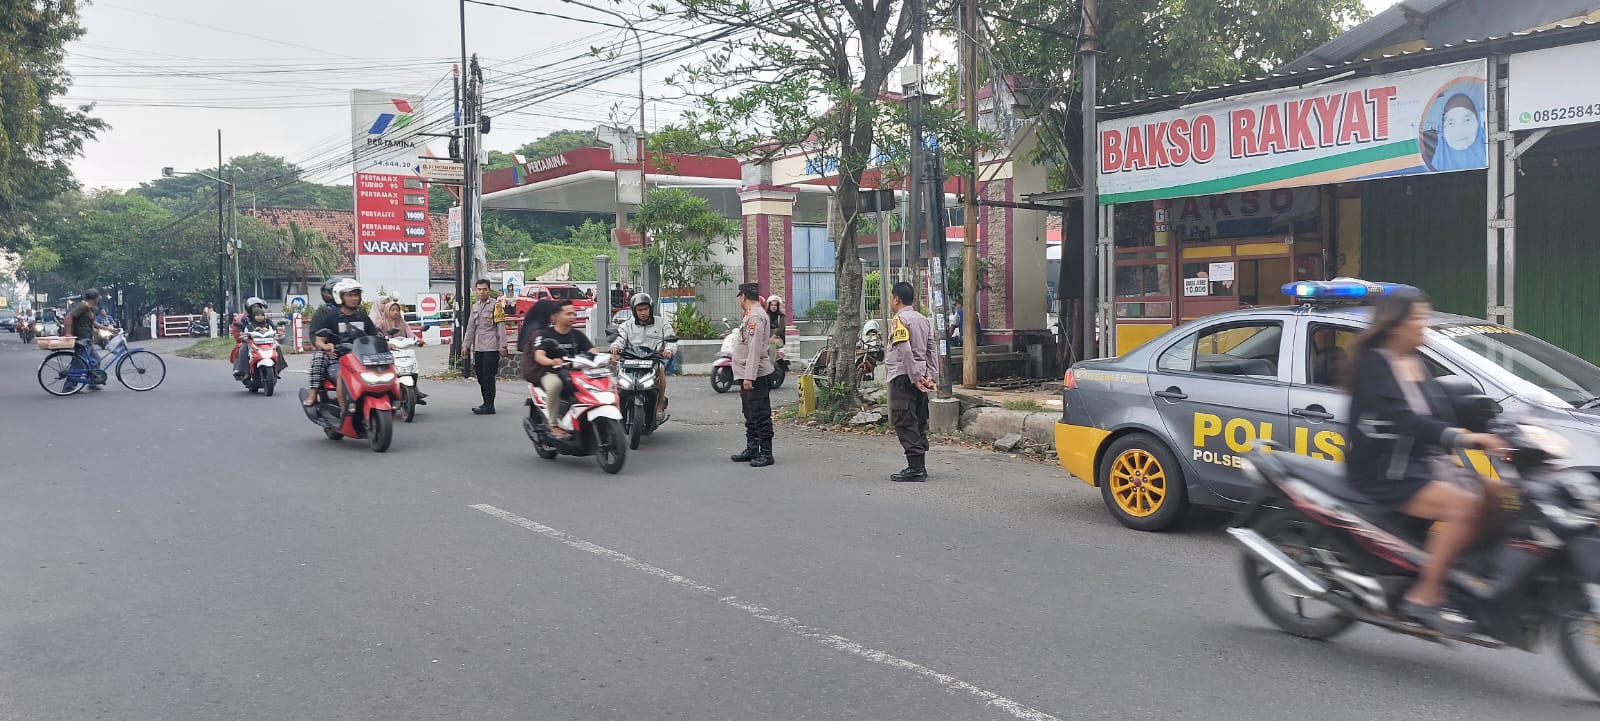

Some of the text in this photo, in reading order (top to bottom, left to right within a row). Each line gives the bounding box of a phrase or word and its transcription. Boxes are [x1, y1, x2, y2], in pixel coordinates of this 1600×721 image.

[1100, 86, 1397, 174] BAKSO RAKYAT
[367, 138, 415, 148] PERTAMINA
[526, 153, 568, 174] PERTAMINA
[360, 174, 398, 183] PERTAMAX
[360, 190, 398, 199] PERTAMAX
[361, 210, 396, 218] PERTALITE
[361, 223, 401, 231] PERTAMINA
